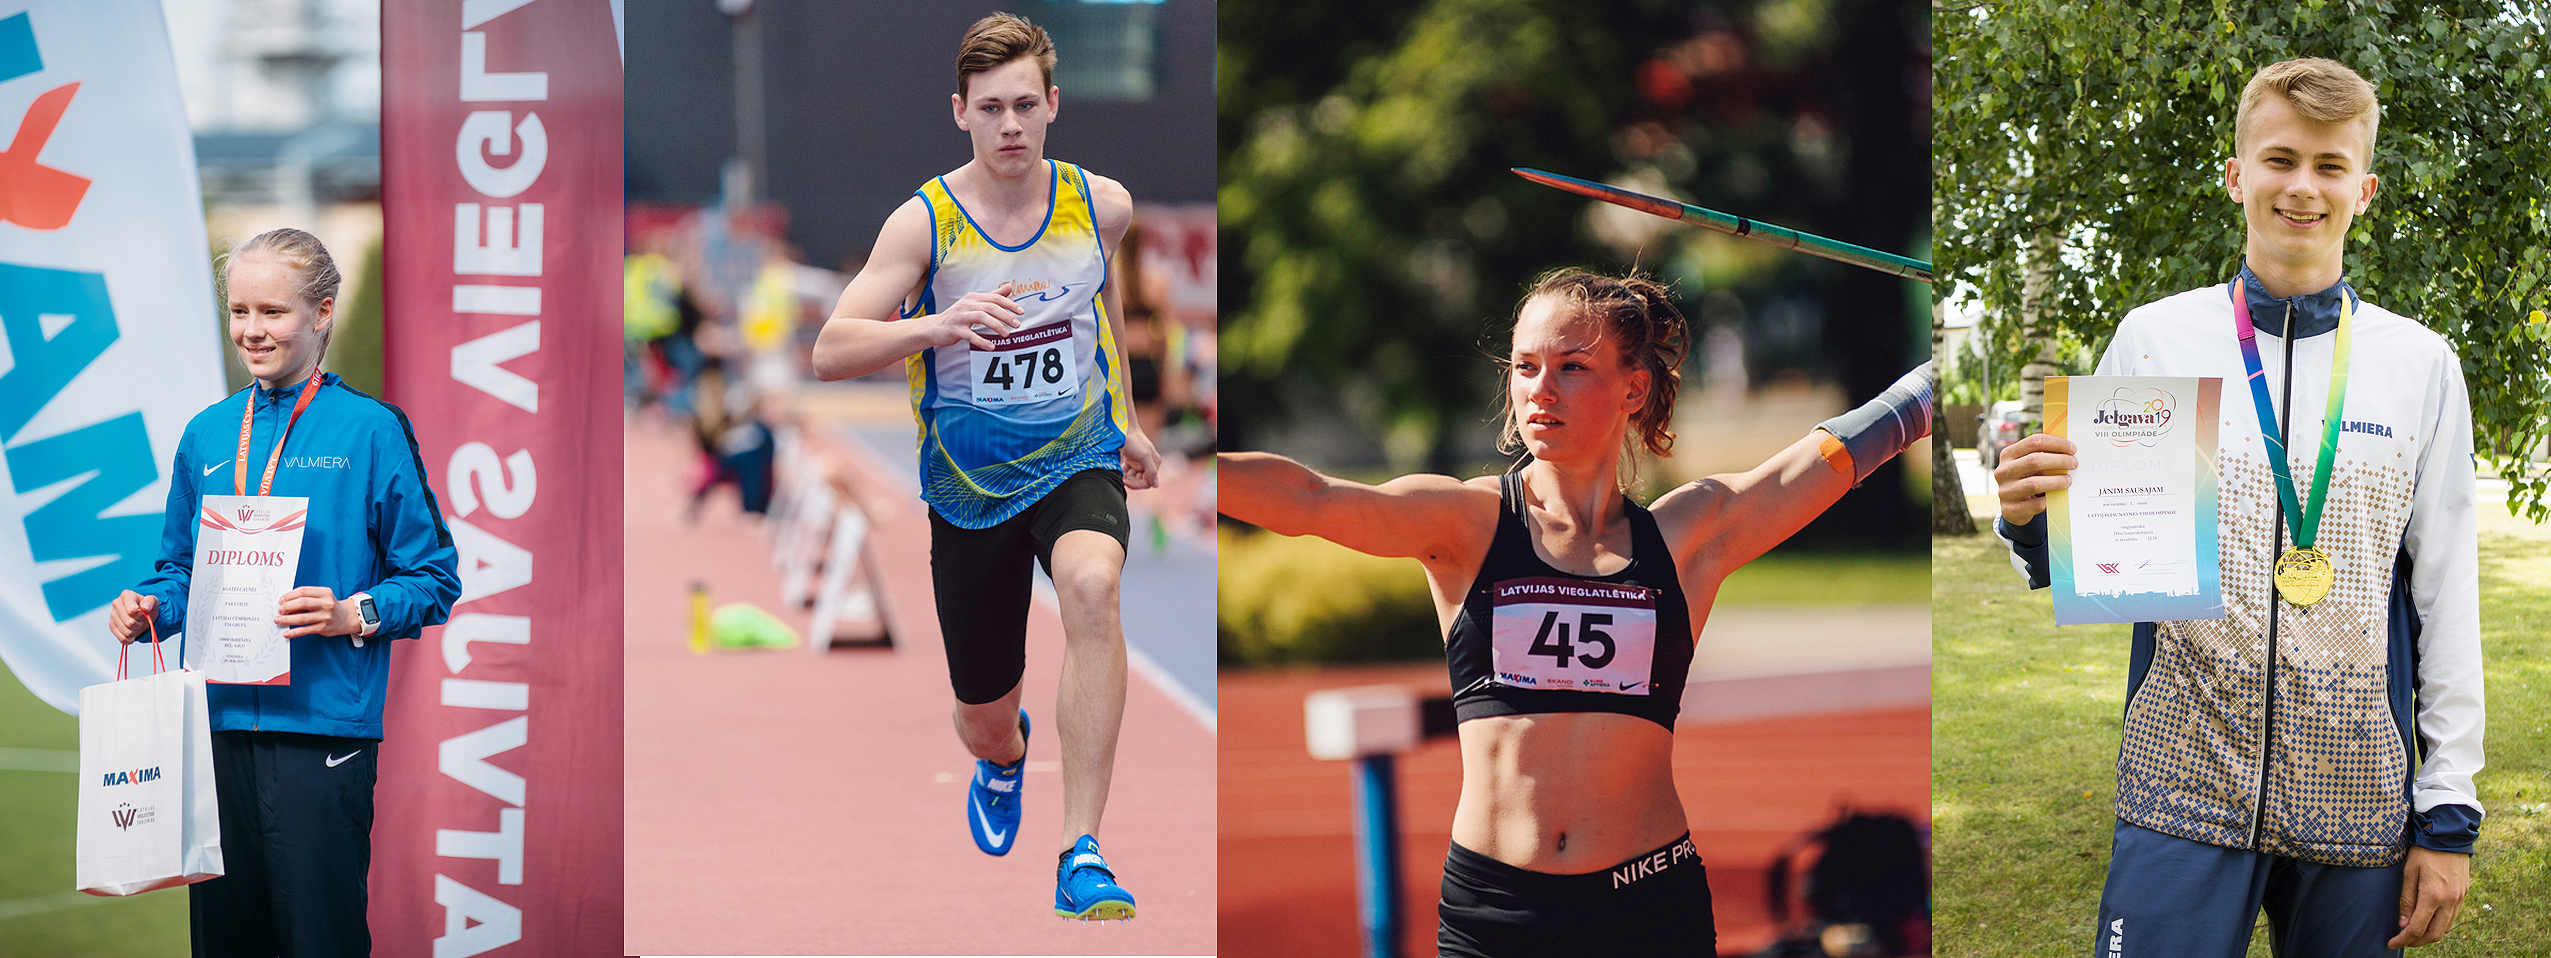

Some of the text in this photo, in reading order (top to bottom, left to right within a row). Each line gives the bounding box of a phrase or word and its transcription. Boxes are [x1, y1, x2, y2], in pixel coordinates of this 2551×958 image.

[983, 347, 1064, 390] 478
[2093, 410, 2154, 430] Jelgava
[2321, 419, 2393, 438] LMIERA
[238, 423, 250, 462] LATVIJAS
[283, 456, 351, 470] VALMIERA
[2091, 459, 2173, 472] DIPLOMS
[260, 457, 278, 496] LATVIJA
[206, 549, 285, 567] DIPLOMS
[1501, 584, 1647, 601] LATVIJAS VIEGLATLĒTIKA
[1527, 611, 1616, 669] 45
[1500, 672, 1537, 685] MAXIMA
[102, 766, 162, 787] MAXIMA
[987, 778, 1017, 793] NIKE
[1612, 839, 1695, 890] NIKE PR
